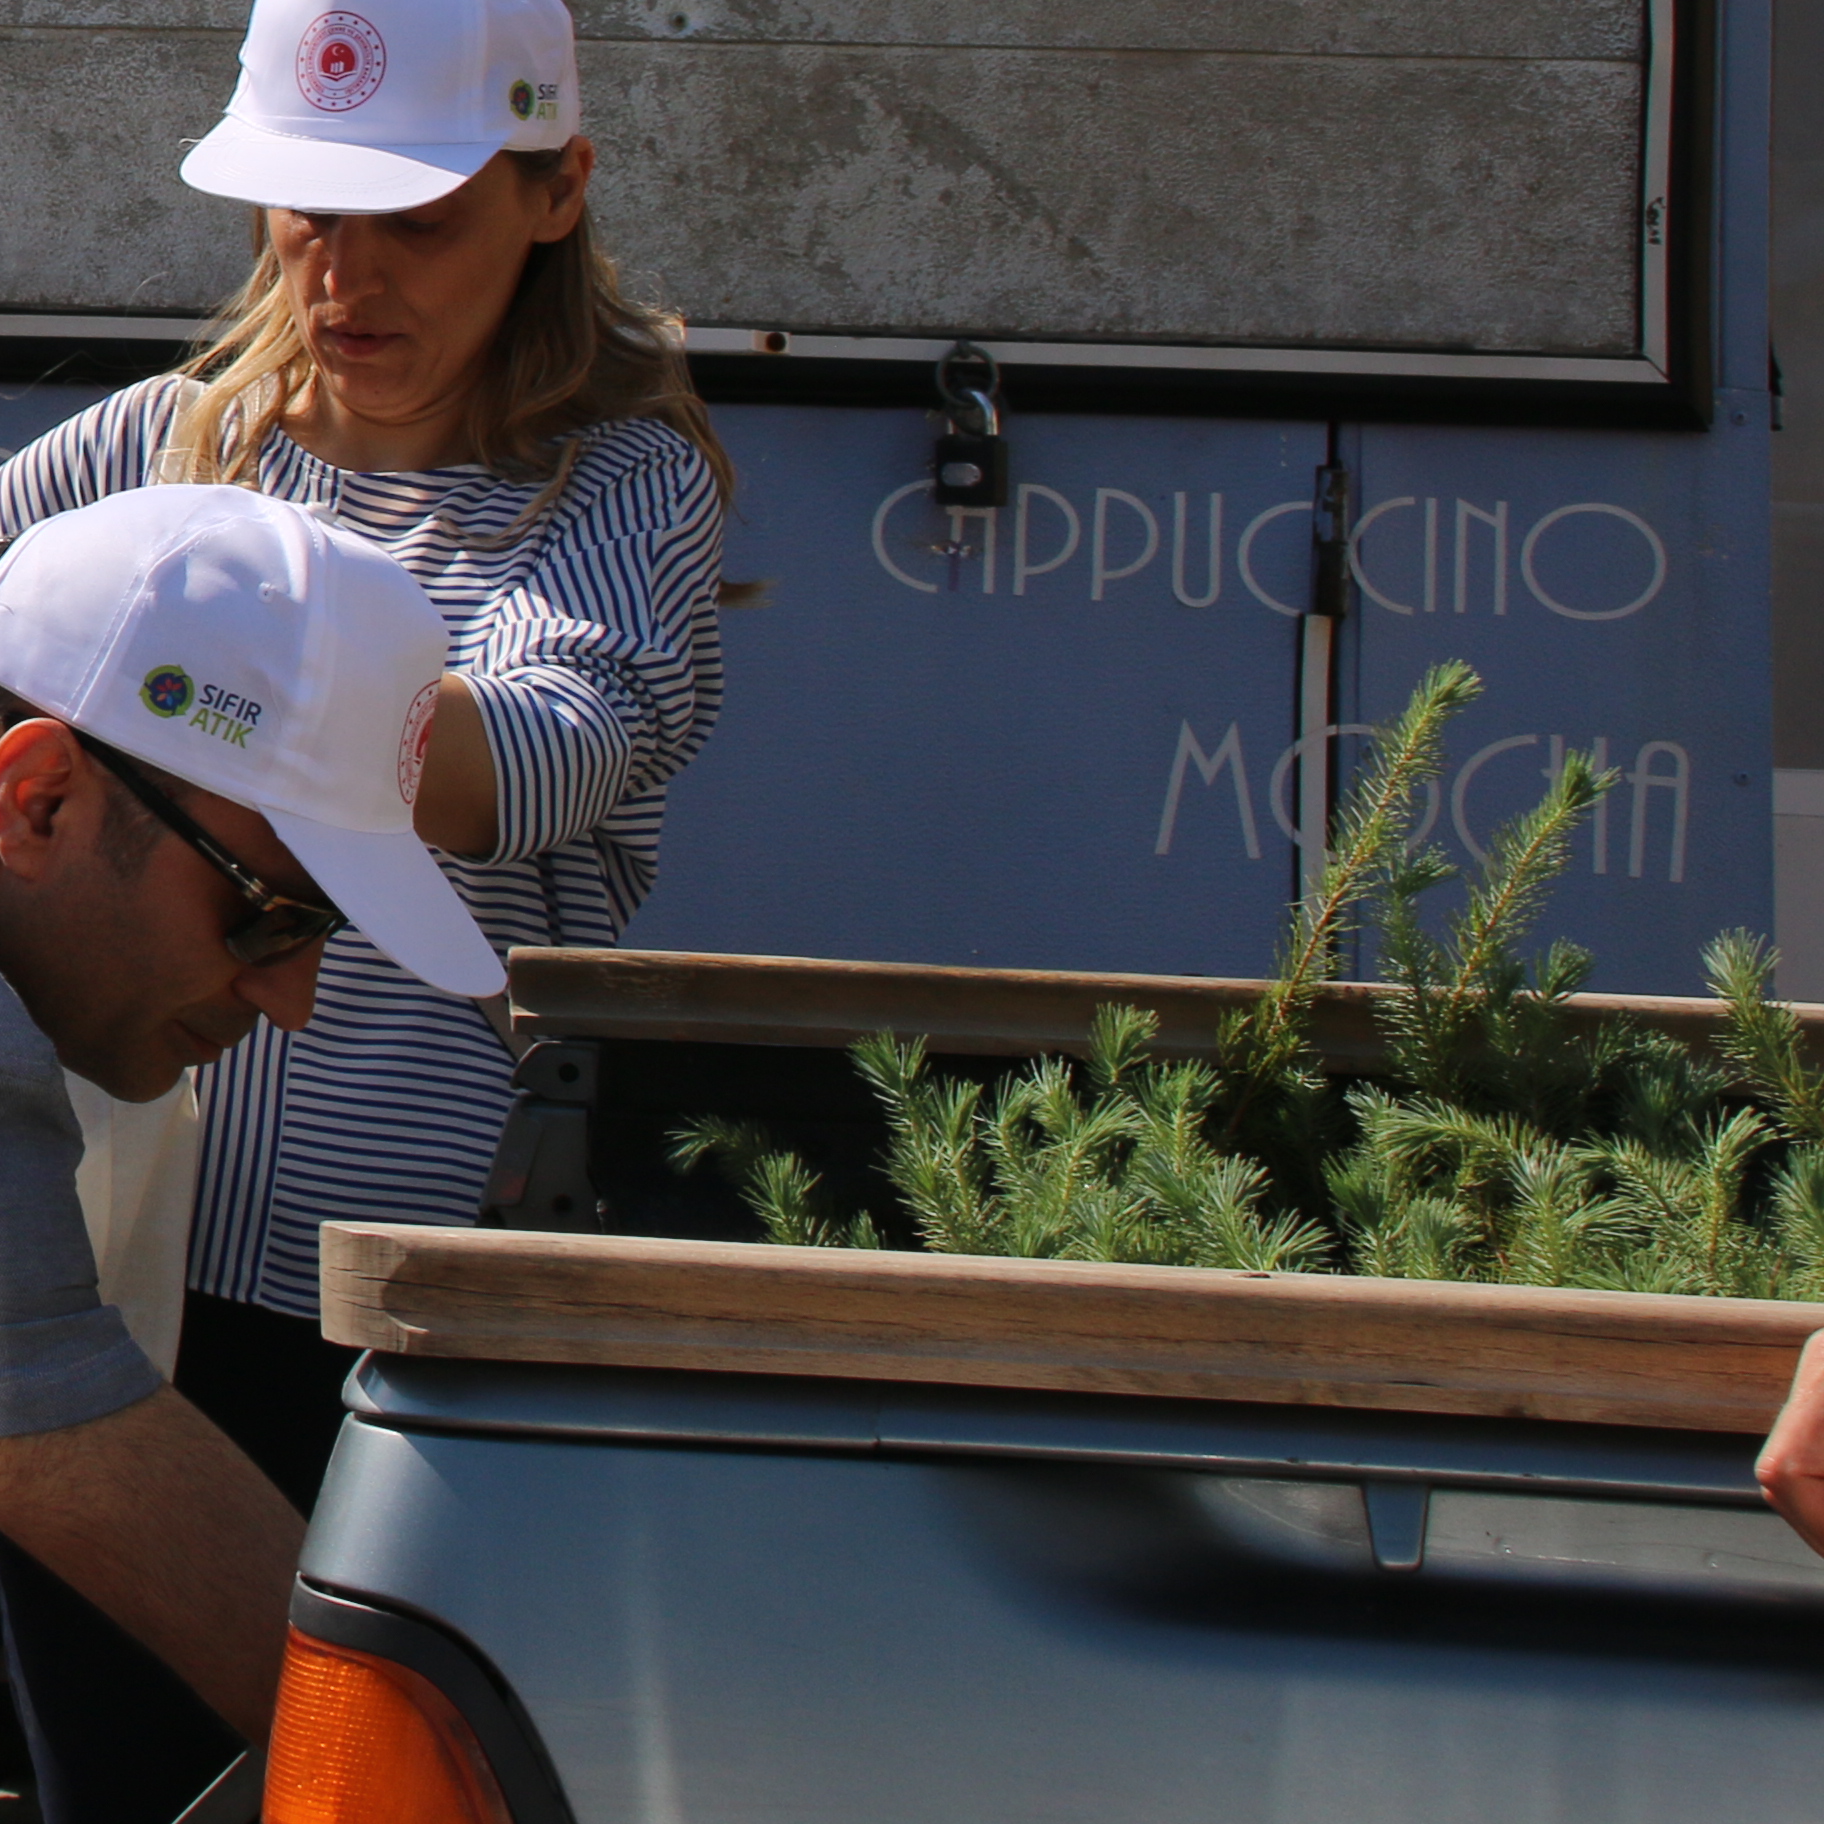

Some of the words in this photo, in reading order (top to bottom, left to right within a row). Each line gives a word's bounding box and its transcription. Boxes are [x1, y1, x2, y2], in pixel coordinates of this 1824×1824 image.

[870, 479, 1669, 622] CAPPUCCINO
[198, 683, 263, 726] SIFIR
[188, 707, 256, 750] ATIK
